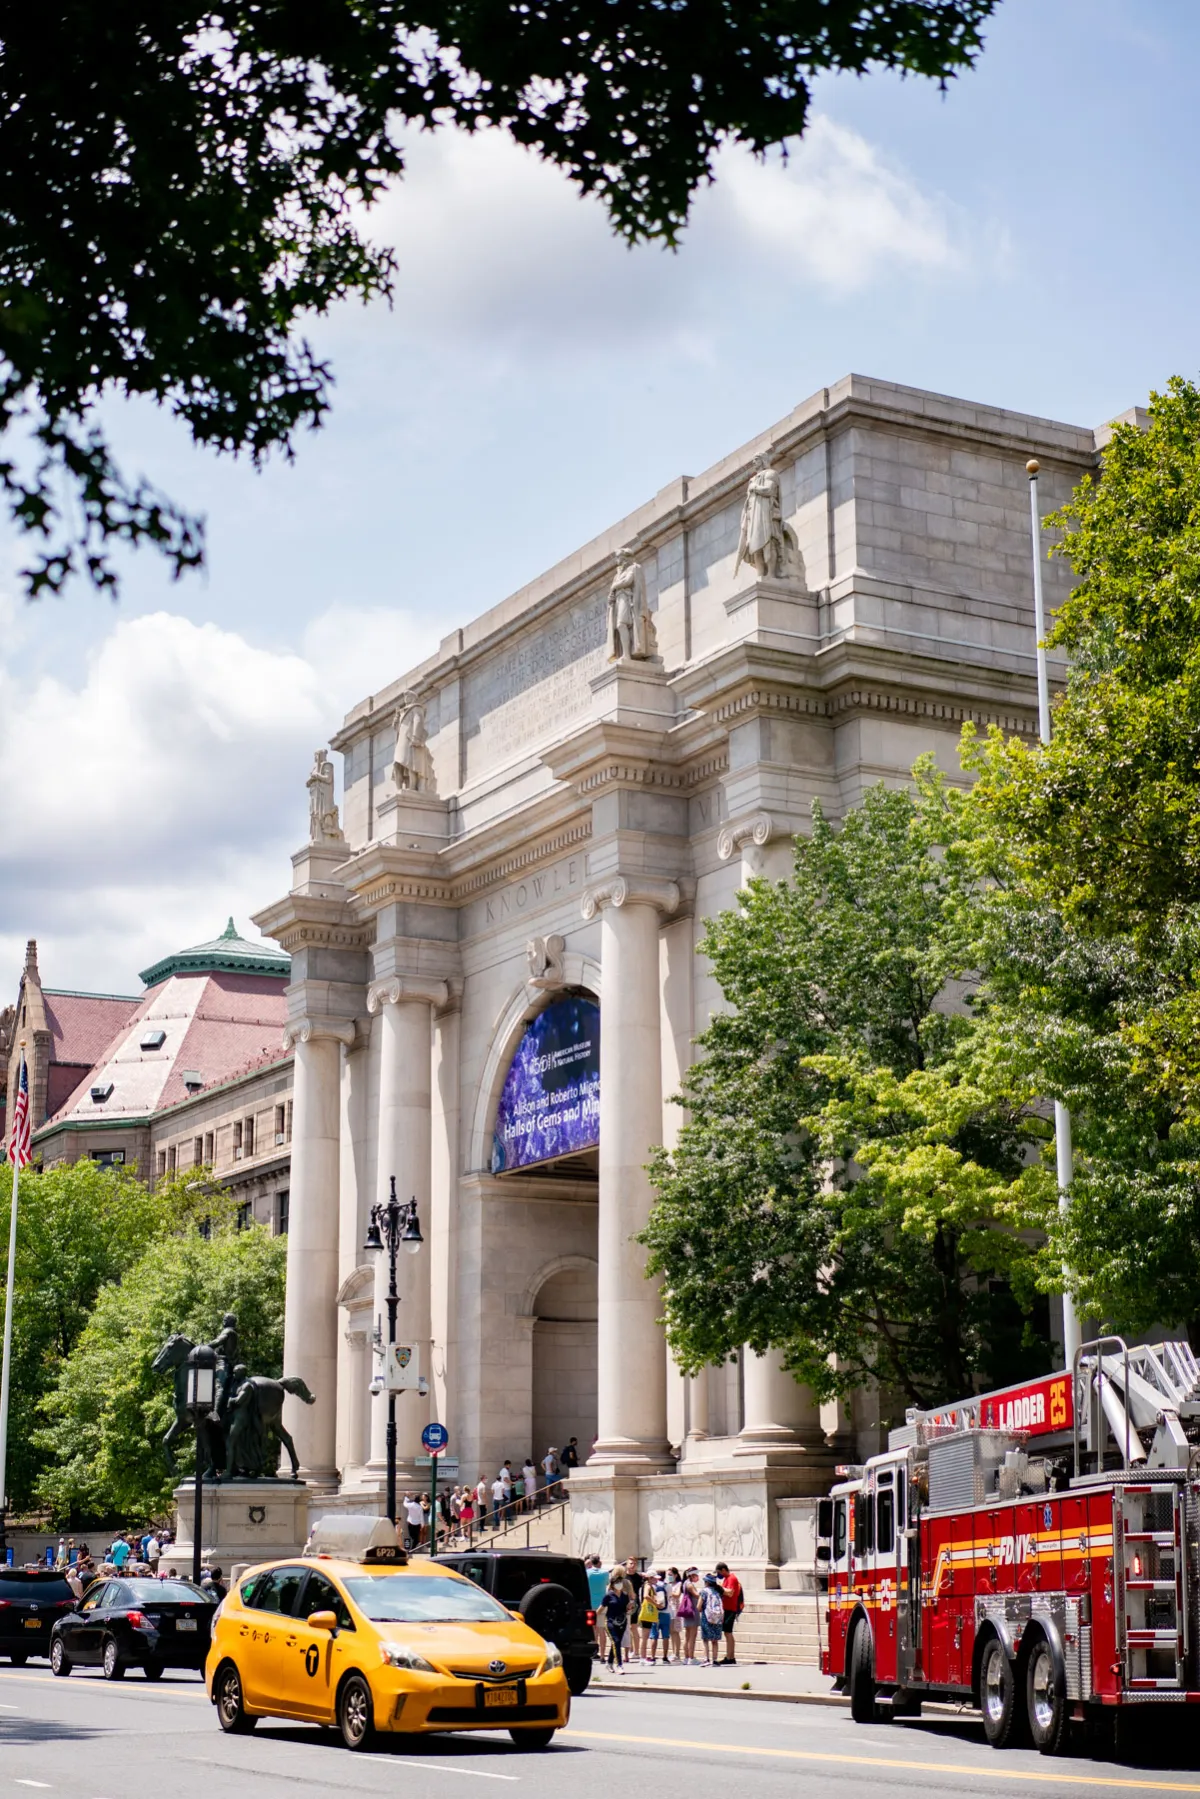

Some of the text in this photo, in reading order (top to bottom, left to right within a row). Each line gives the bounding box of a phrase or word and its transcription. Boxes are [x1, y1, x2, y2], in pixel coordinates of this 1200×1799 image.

[510, 615, 606, 687] THEODORE ROOSEVELT
[574, 1049, 591, 1061] HISTORY
[513, 1099, 535, 1116] Allison
[536, 1093, 549, 1110] and
[550, 1087, 578, 1106] Roberto
[504, 1119, 525, 1140] Halls
[526, 1114, 536, 1134] of
[537, 1112, 561, 1130] Gems
[563, 1101, 580, 1121] and
[999, 1380, 1066, 1430] LADDER 25
[998, 1533, 1030, 1566] FDNY
[881, 1578, 891, 1611] 25
